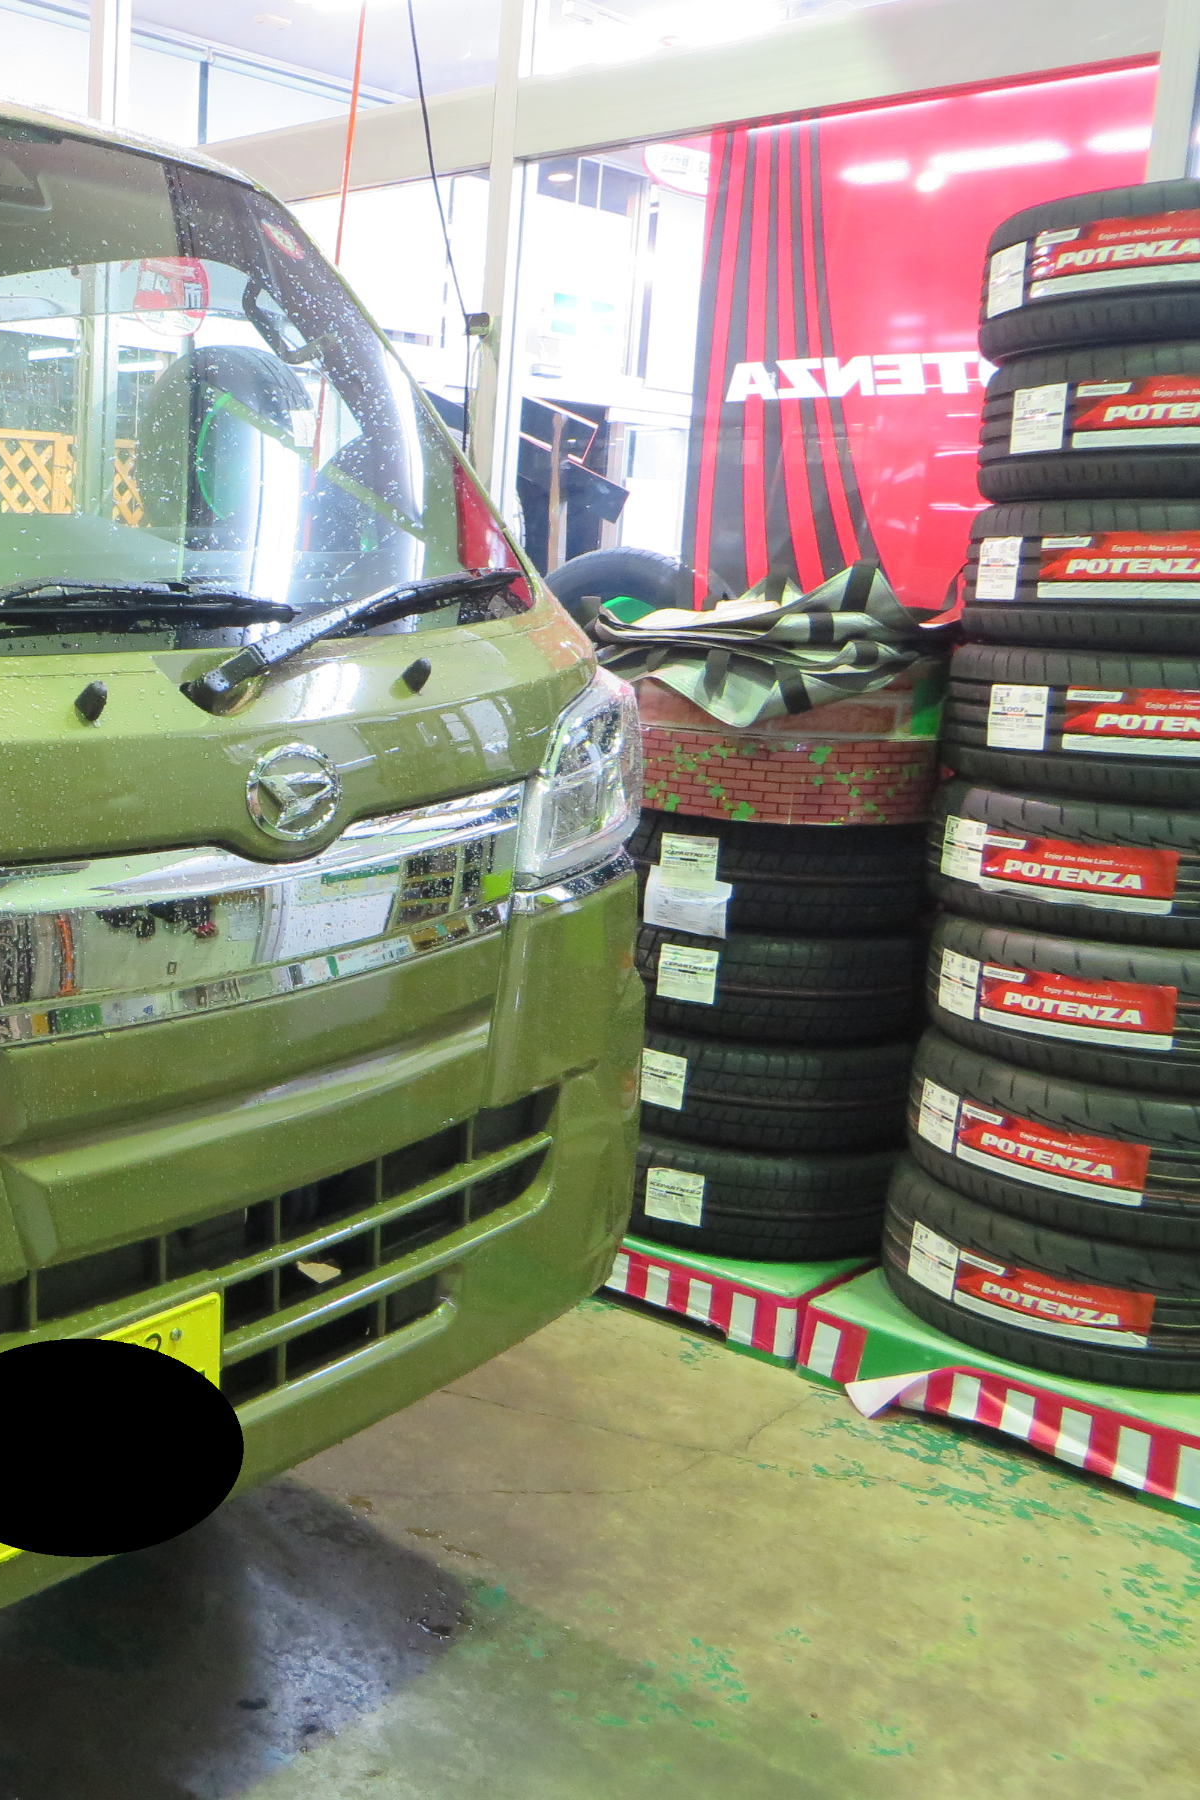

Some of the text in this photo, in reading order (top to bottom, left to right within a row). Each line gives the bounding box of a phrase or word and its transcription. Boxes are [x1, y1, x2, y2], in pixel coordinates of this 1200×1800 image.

[1055, 237, 1200, 270] POTENZA
[1145, 701, 1167, 710] Enjoy
[1044, 851, 1063, 861] Enjoy
[1077, 856, 1093, 864] New
[1094, 858, 1114, 866] Limit
[1002, 858, 1142, 890] POTENZA
[1043, 985, 1112, 1001] Enjoy the New Limit
[1002, 991, 1142, 1025] POTENZA
[980, 1131, 1114, 1180] POTENZA
[1019, 1131, 1038, 1141] Enjoy
[1052, 1139, 1067, 1149] New
[1068, 1143, 1088, 1154] Limit
[981, 1280, 1120, 1326] POTENZA
[1023, 1281, 1042, 1292] Enjoy
[1056, 1289, 1073, 1299] New
